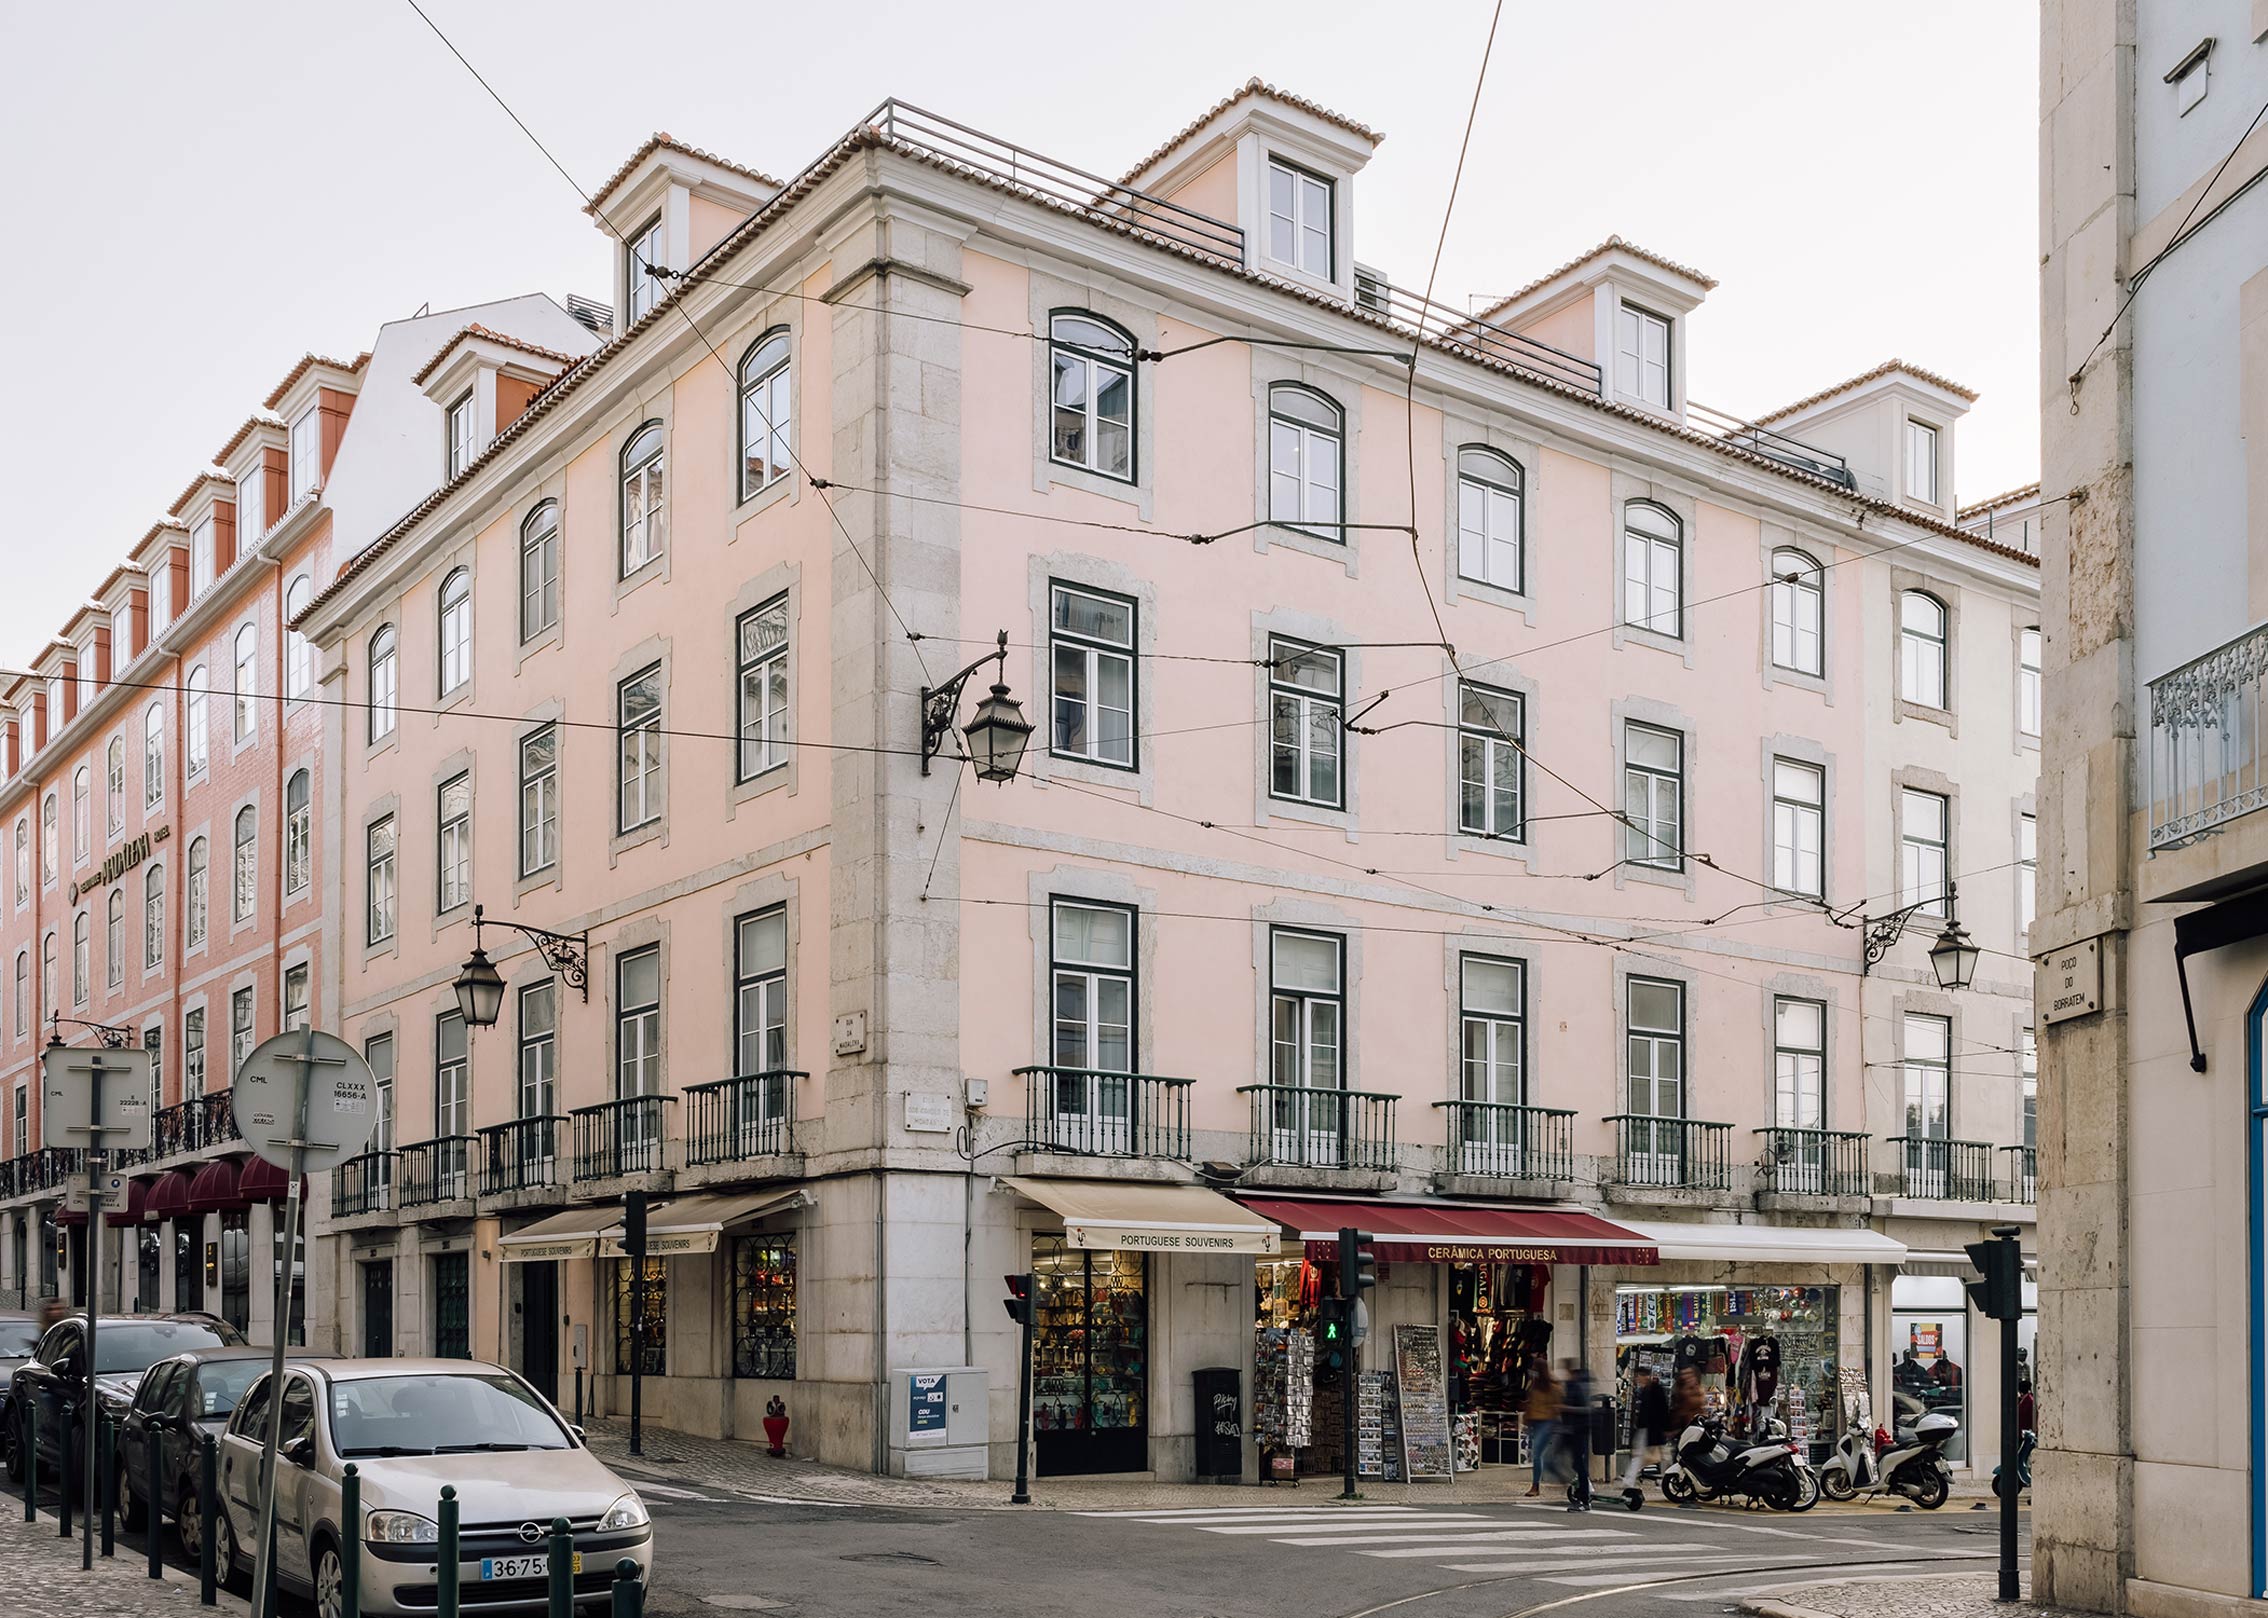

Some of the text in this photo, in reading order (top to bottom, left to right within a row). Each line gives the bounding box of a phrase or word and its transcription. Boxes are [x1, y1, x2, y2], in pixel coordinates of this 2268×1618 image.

[2064, 976, 2074, 989] DO
[2053, 992, 2085, 1011] BORRATEM
[250, 1076, 268, 1084] CML
[336, 1082, 365, 1091] CLXXX
[661, 1239, 690, 1249] SOUVENIRS
[1121, 1235, 1234, 1248] PORTUGUESE SOUVENIRS
[1428, 1245, 1557, 1261] CERÂMICA PORTUGUESA
